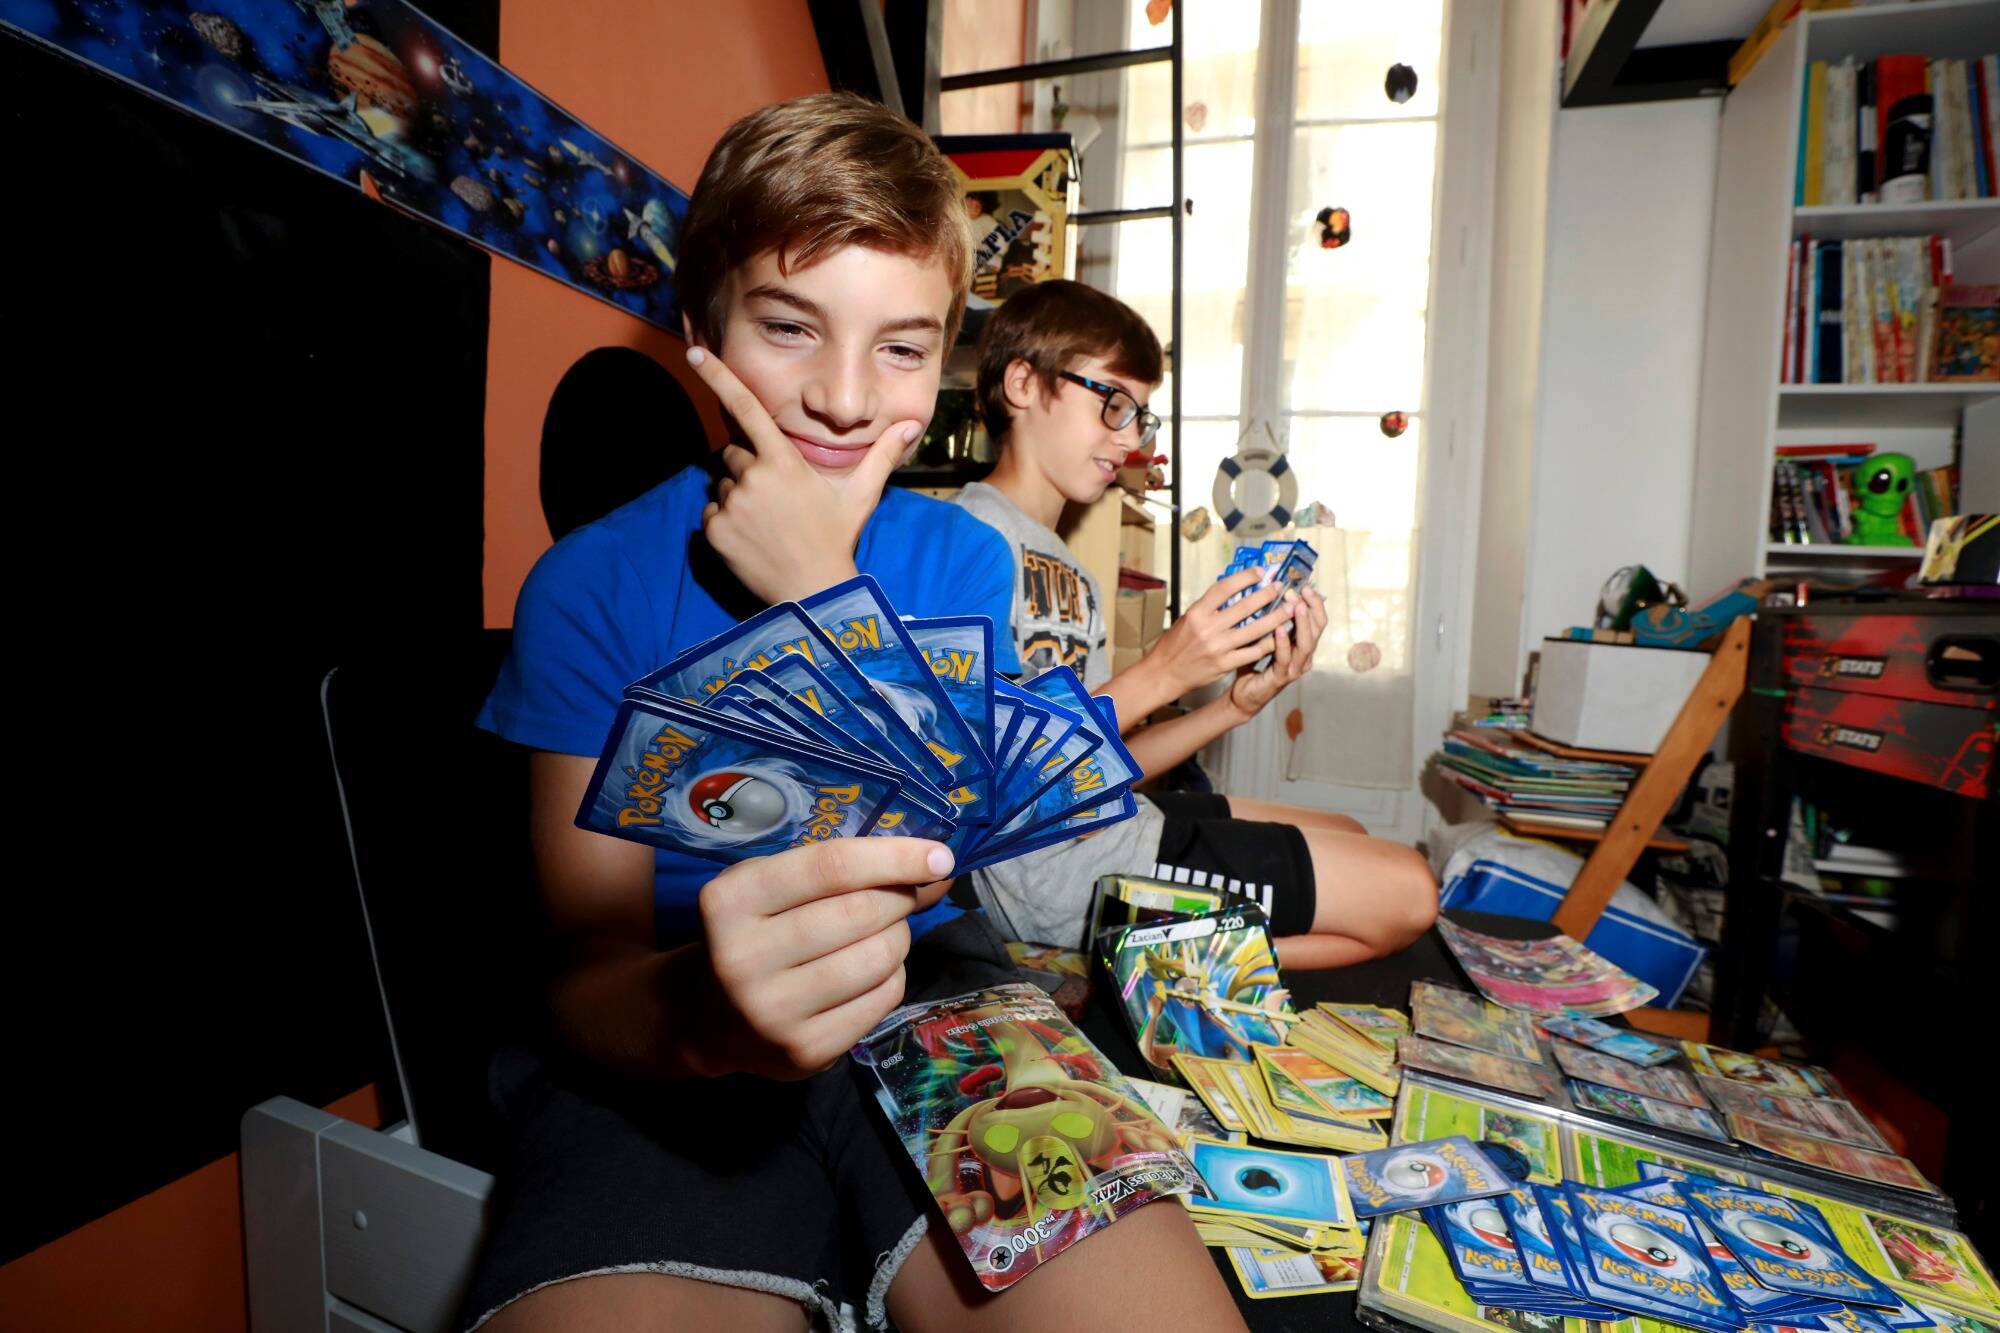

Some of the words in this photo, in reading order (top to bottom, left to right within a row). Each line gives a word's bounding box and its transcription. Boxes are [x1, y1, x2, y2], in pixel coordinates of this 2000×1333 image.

[1221, 915, 1246, 930] 220
[1128, 1165, 1183, 1188] Miaouss
[1010, 1222, 1053, 1255] 300
